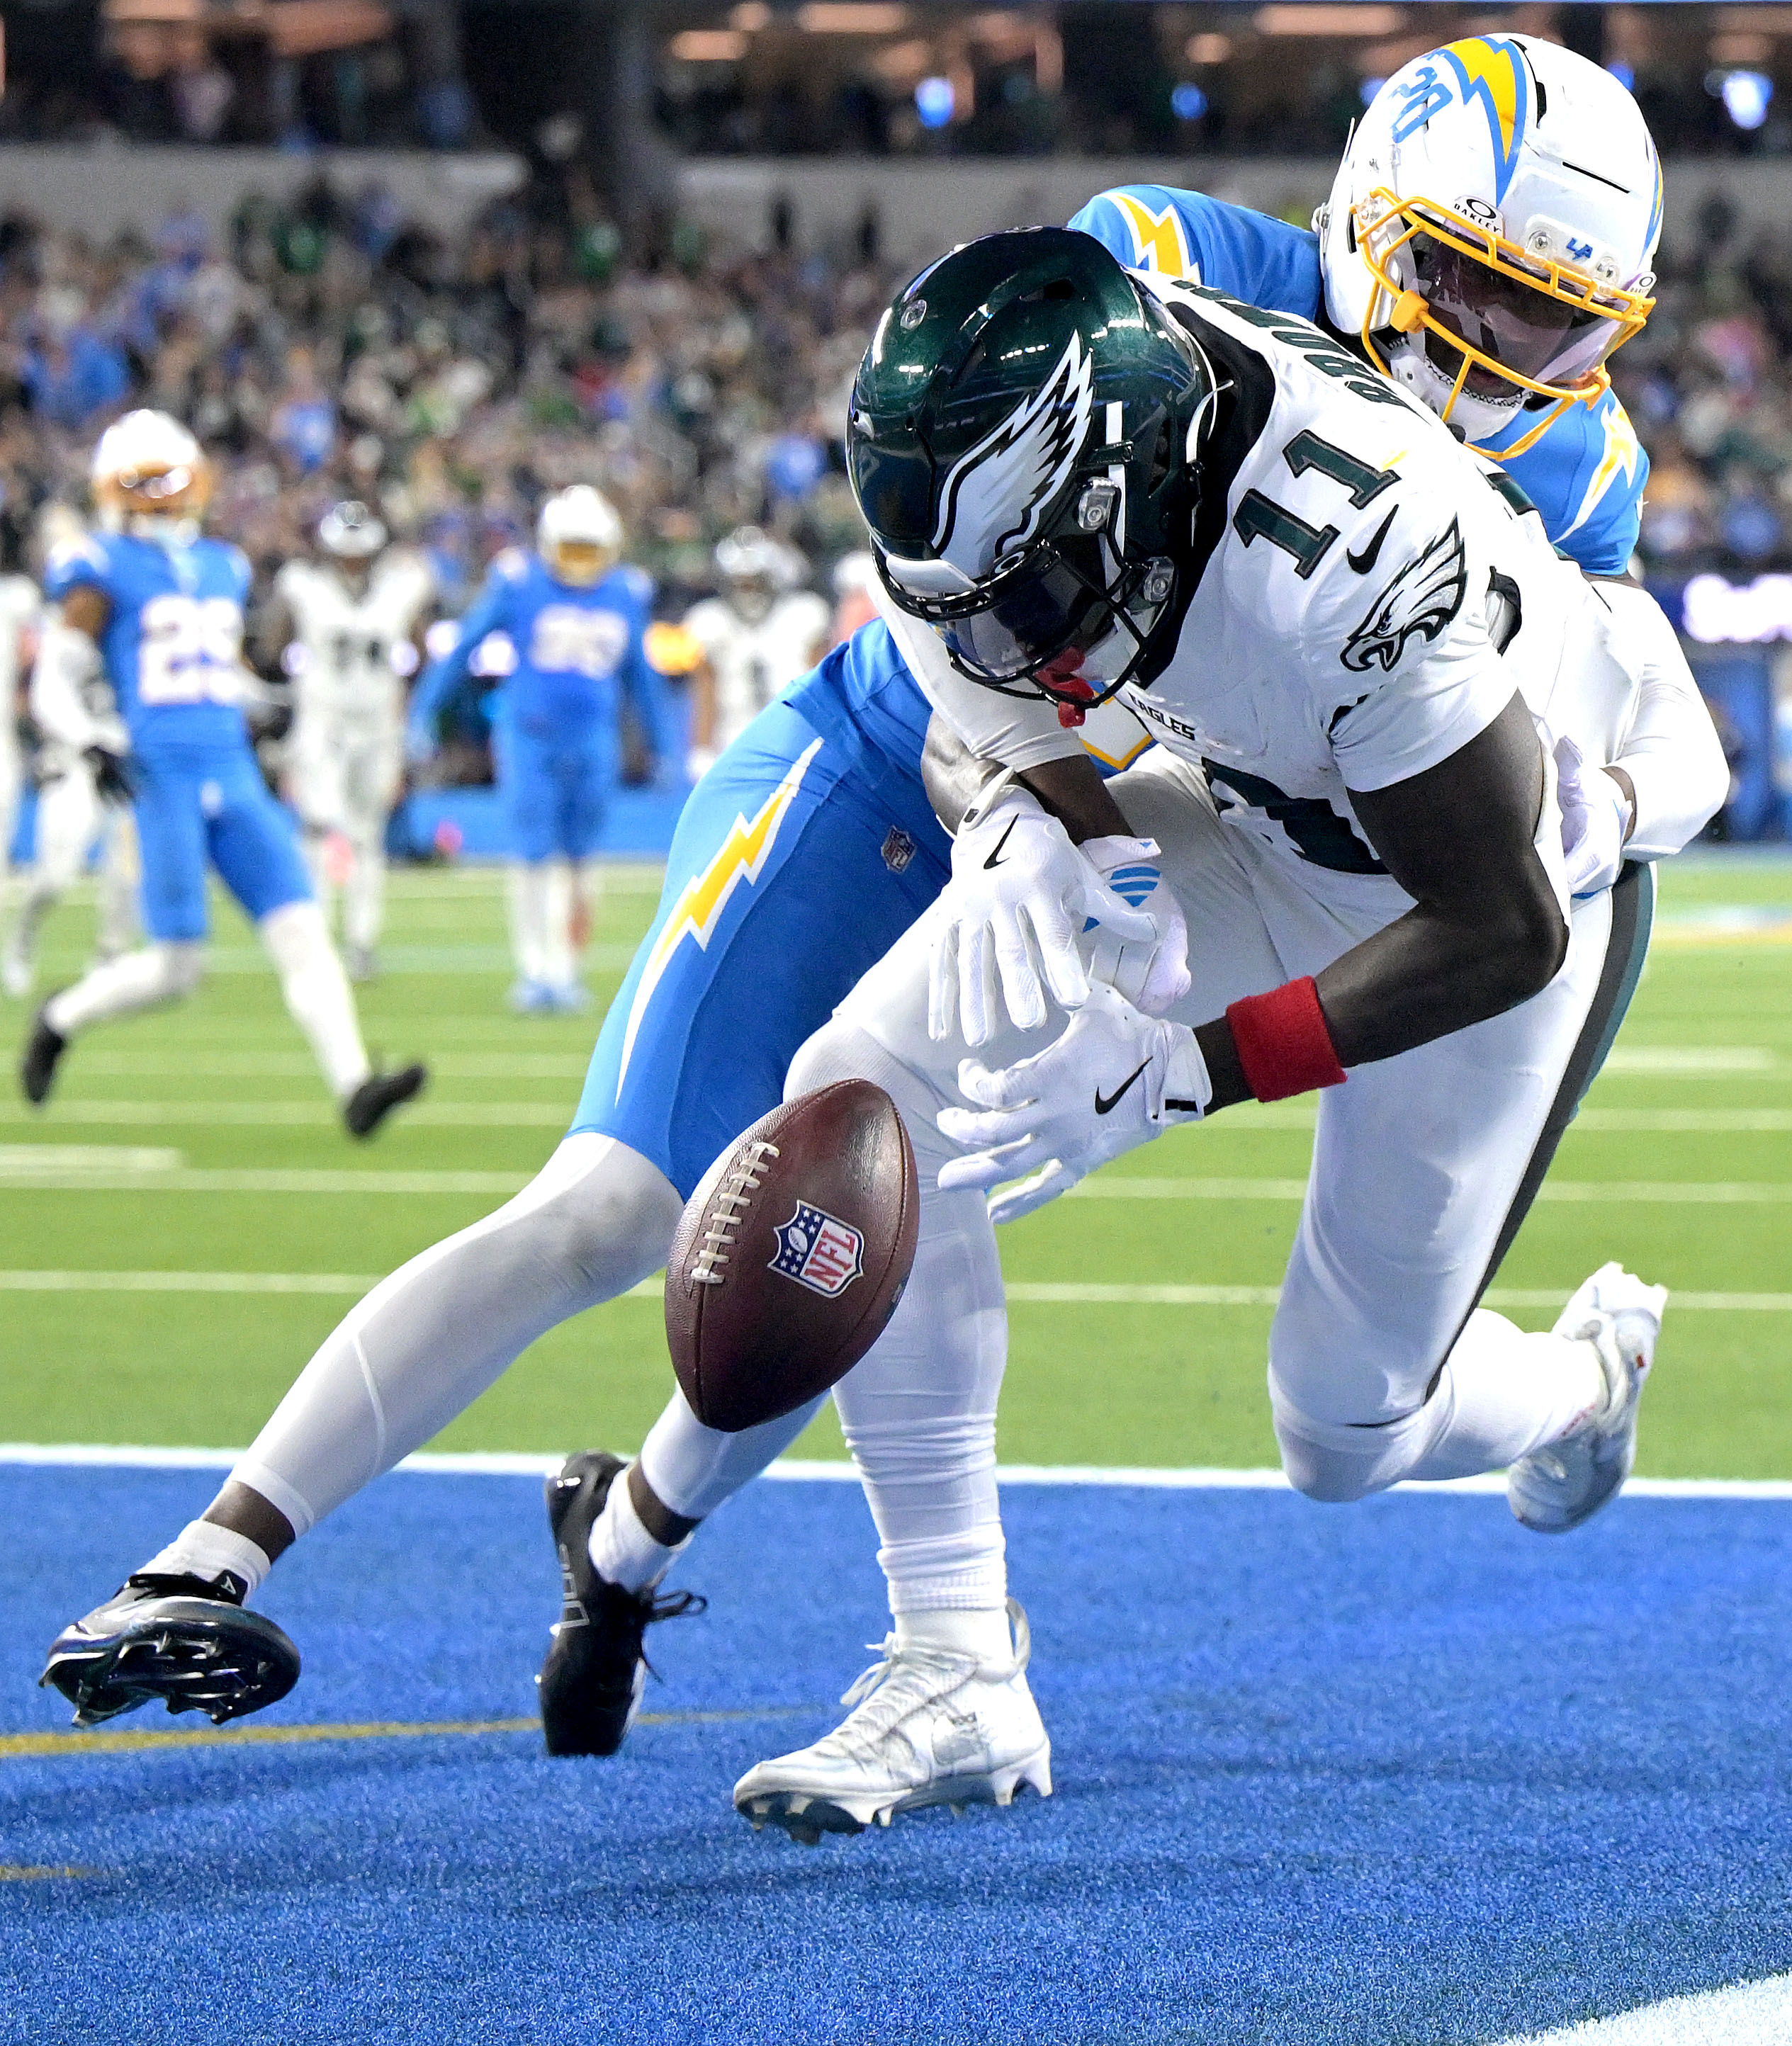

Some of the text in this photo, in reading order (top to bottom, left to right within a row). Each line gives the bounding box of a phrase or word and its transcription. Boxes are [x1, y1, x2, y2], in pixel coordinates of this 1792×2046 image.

[1453, 203, 1501, 232] OAKLEY
[1565, 237, 1593, 260] LA
[1233, 429, 1402, 580] 11
[139, 594, 241, 706] 2
[804, 1228, 856, 1289] NFL
